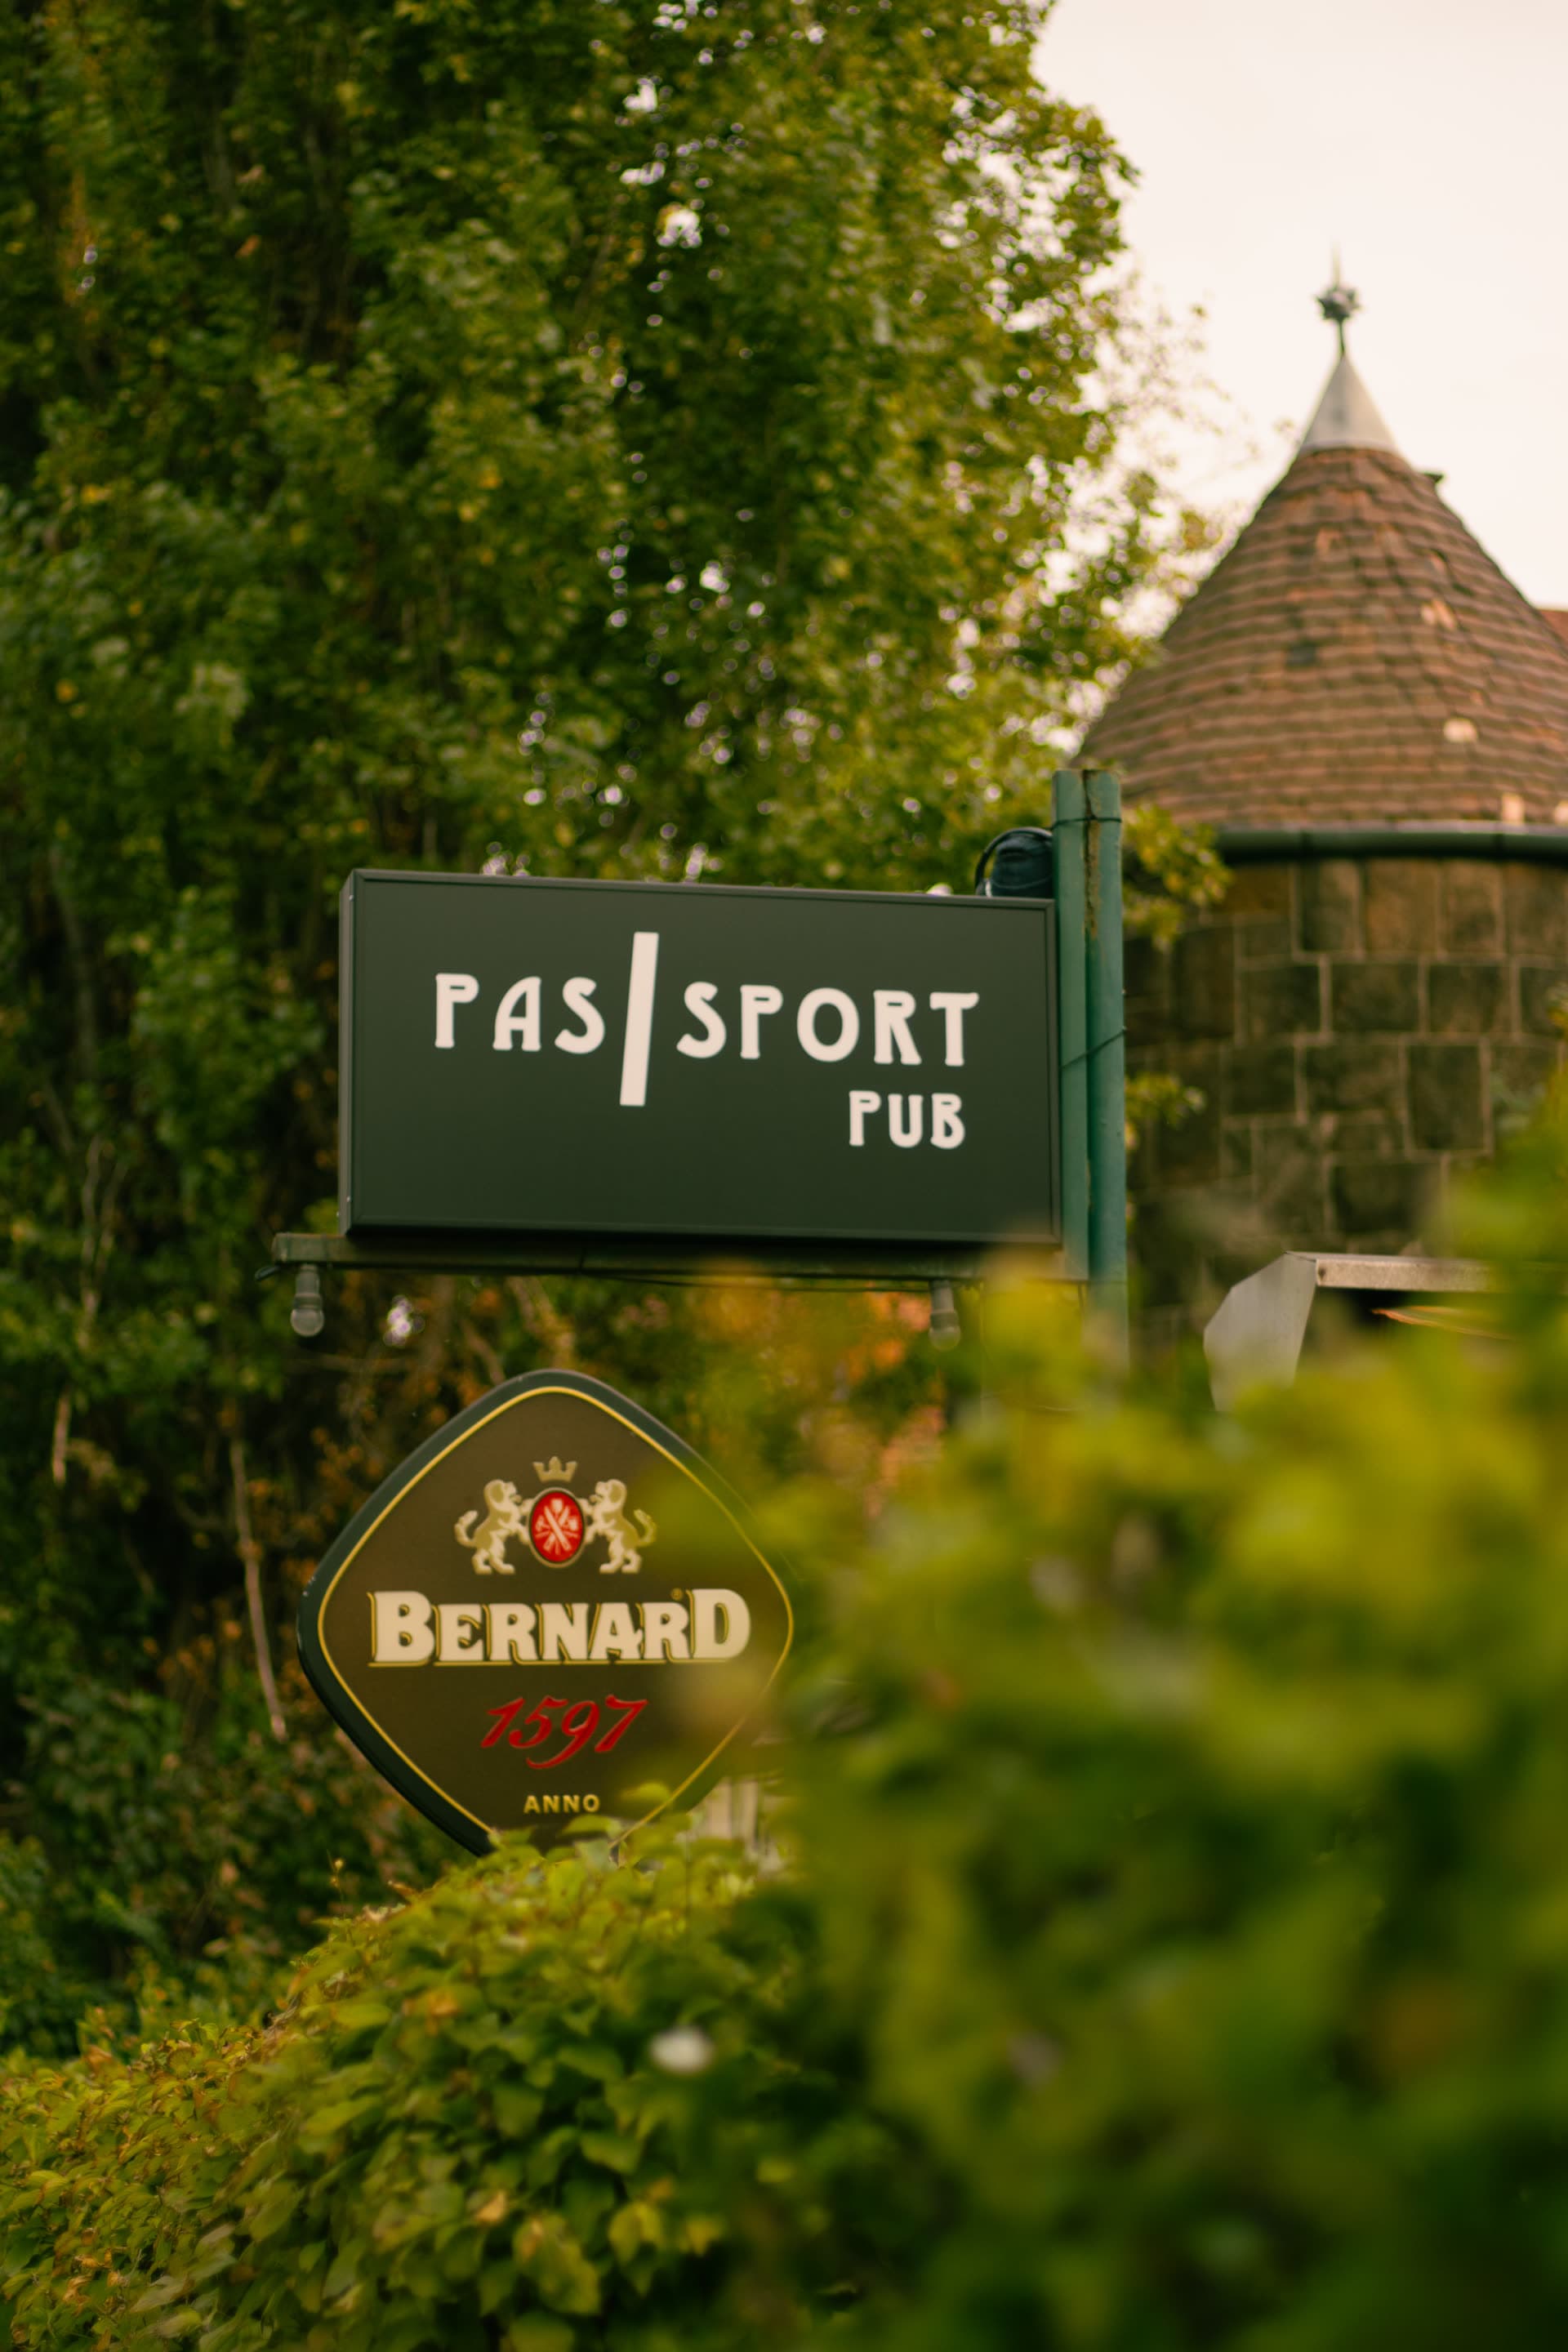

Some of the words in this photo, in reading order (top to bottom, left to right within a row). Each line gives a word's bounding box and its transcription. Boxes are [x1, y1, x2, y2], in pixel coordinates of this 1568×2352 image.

[849, 1090, 965, 1149] PUB
[368, 1588, 751, 1666] BERNARD
[480, 1694, 648, 1769] 1597
[523, 1793, 600, 1814] ANNO
